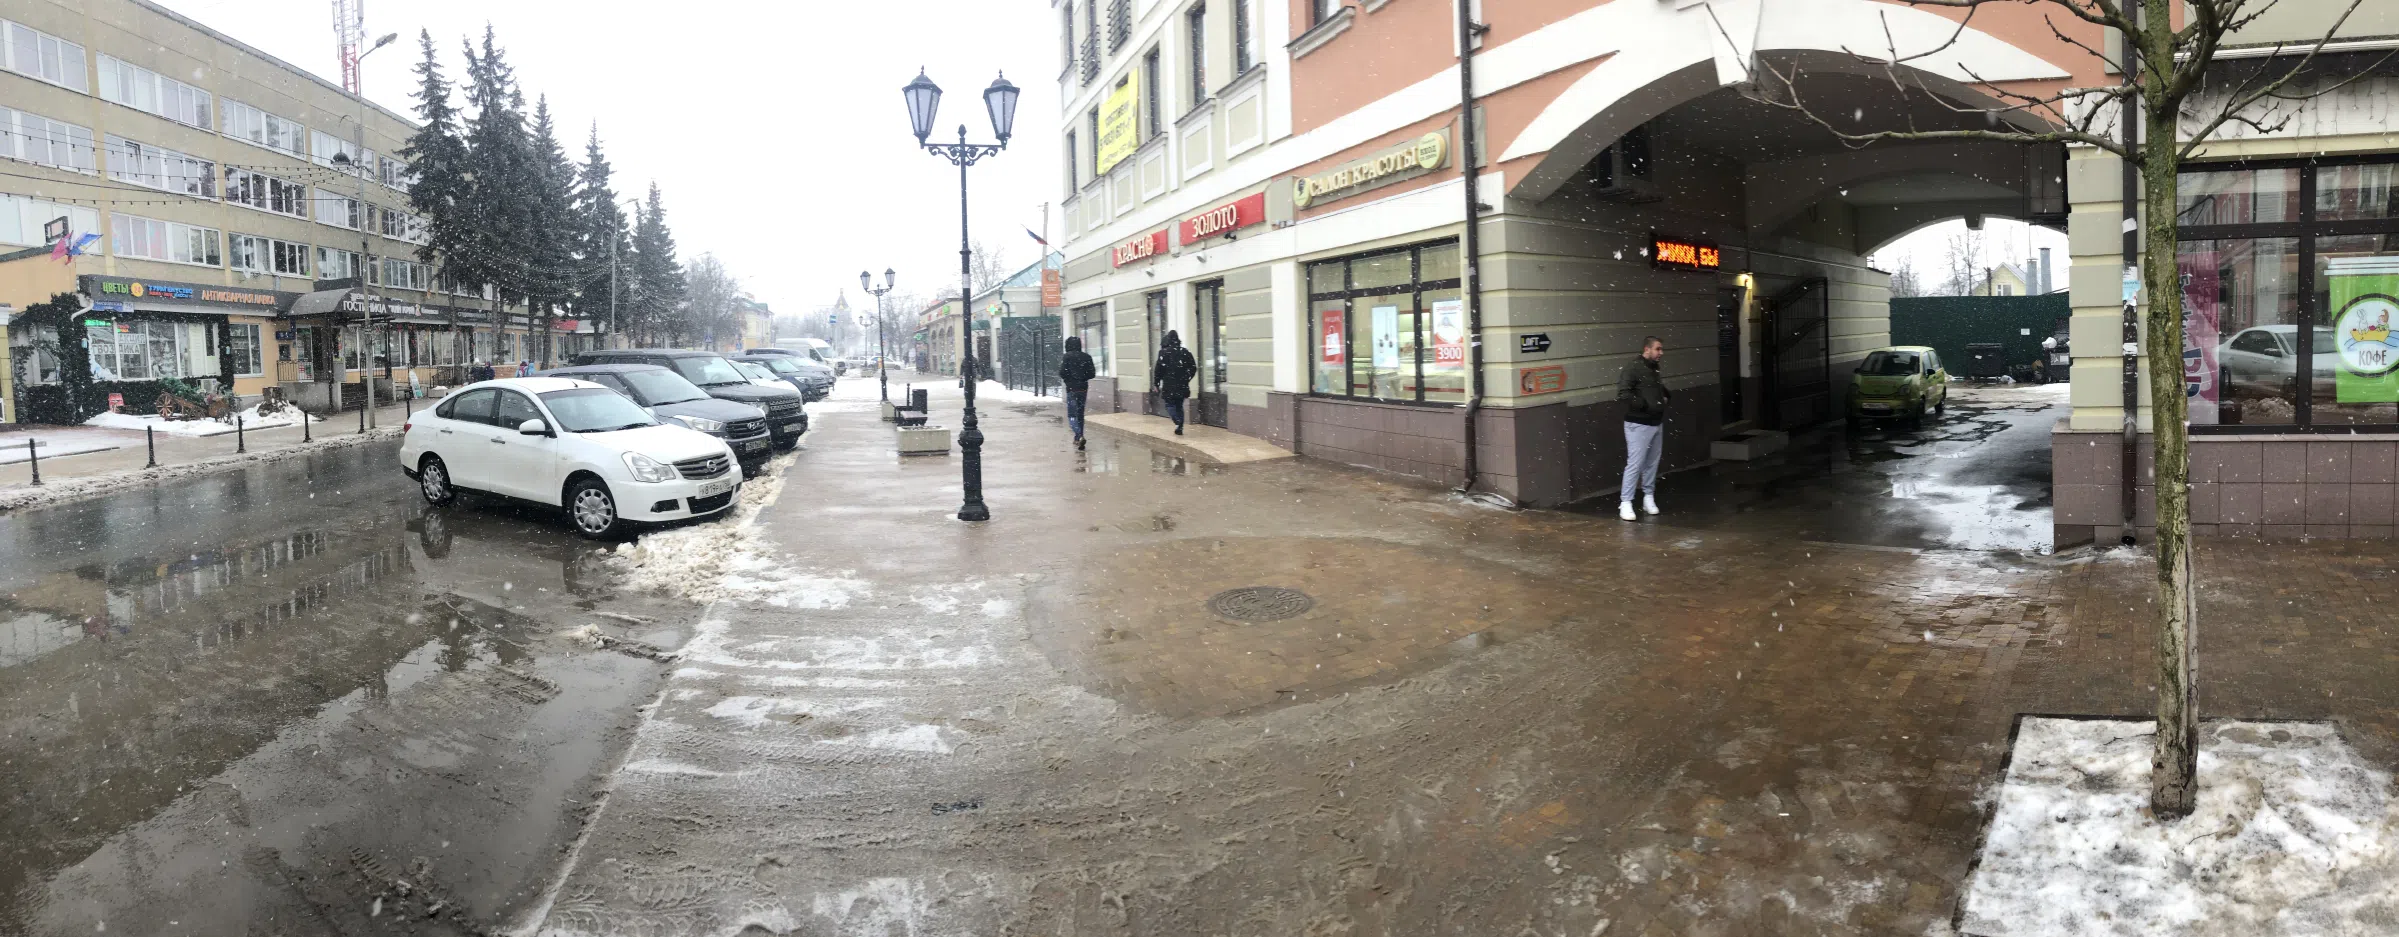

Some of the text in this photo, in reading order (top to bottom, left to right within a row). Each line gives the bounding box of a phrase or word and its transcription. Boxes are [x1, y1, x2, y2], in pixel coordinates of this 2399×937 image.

[1310, 146, 1418, 197] САЛОН КРАСОТЫ
[1191, 204, 1237, 238] ЗОЛОТО
[102, 282, 129, 294] ЦВЕТЫ
[202, 289, 276, 305] АНТИКВАРНАЯ ЛАВКА
[119, 334, 145, 344] АКЦИЯ
[1521, 336, 1540, 347] LOFT
[1438, 347, 1462, 360] 3900
[2358, 350, 2387, 366] КОФЕ
